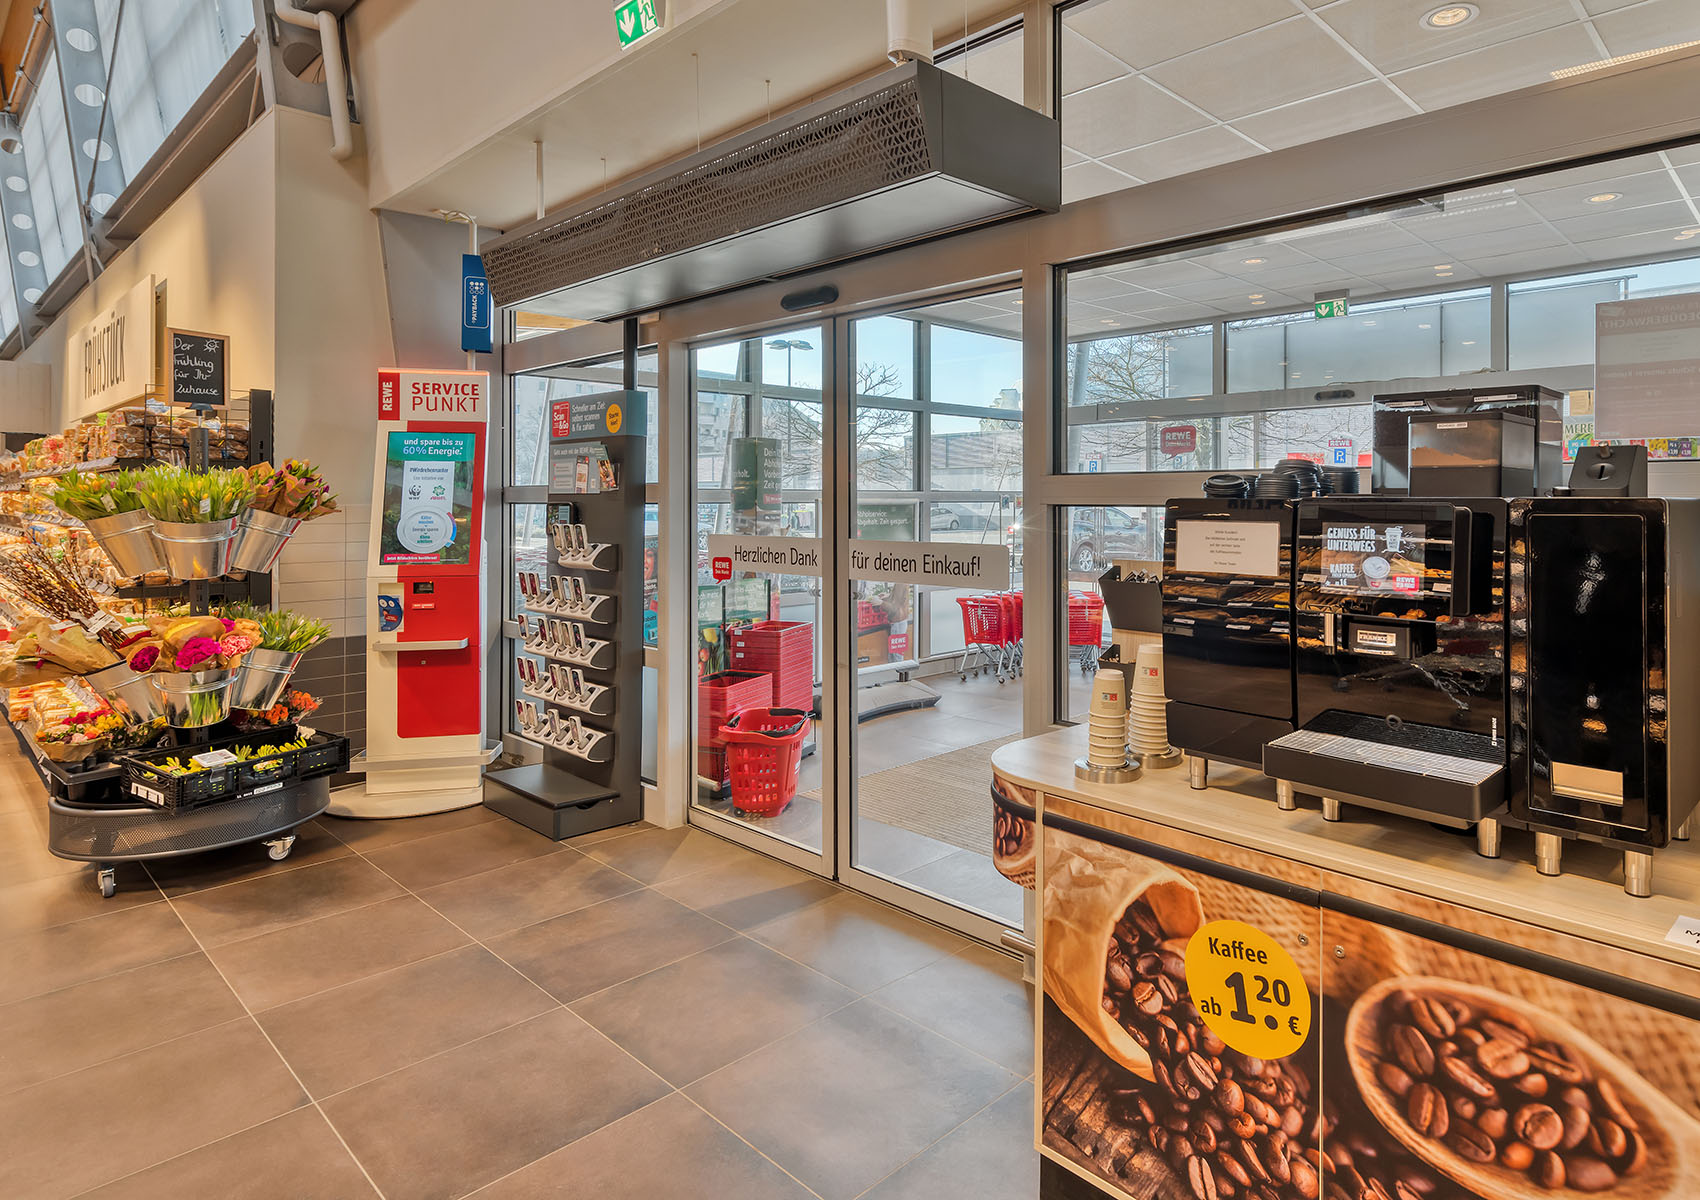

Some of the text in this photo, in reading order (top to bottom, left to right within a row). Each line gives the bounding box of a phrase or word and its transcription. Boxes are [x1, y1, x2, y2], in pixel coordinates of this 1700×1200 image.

[174, 337, 194, 350] Der
[85, 311, 125, 400] FRÜHSTÜCK
[174, 353, 214, 373] Frühling
[174, 369, 211, 380] für Ihr
[176, 383, 220, 396] Zuhause
[382, 381, 392, 411] REWE
[412, 382, 480, 396] SERVICE
[412, 396, 480, 412] PUNKT
[554, 412, 564, 421] Scan
[1165, 432, 1191, 440] REWE
[403, 446, 427, 454] 60%
[1327, 526, 1376, 540] GENUSS FÜR
[1327, 540, 1376, 552] UNTERWEGS
[734, 544, 818, 568] Herzlichen Dank
[852, 551, 981, 577] für deinen Einkauf!
[1330, 564, 1355, 573] KAFFEE
[1208, 936, 1268, 964] Kaffee
[1200, 996, 1221, 1016] ab
[1288, 1016, 1302, 1035] €
